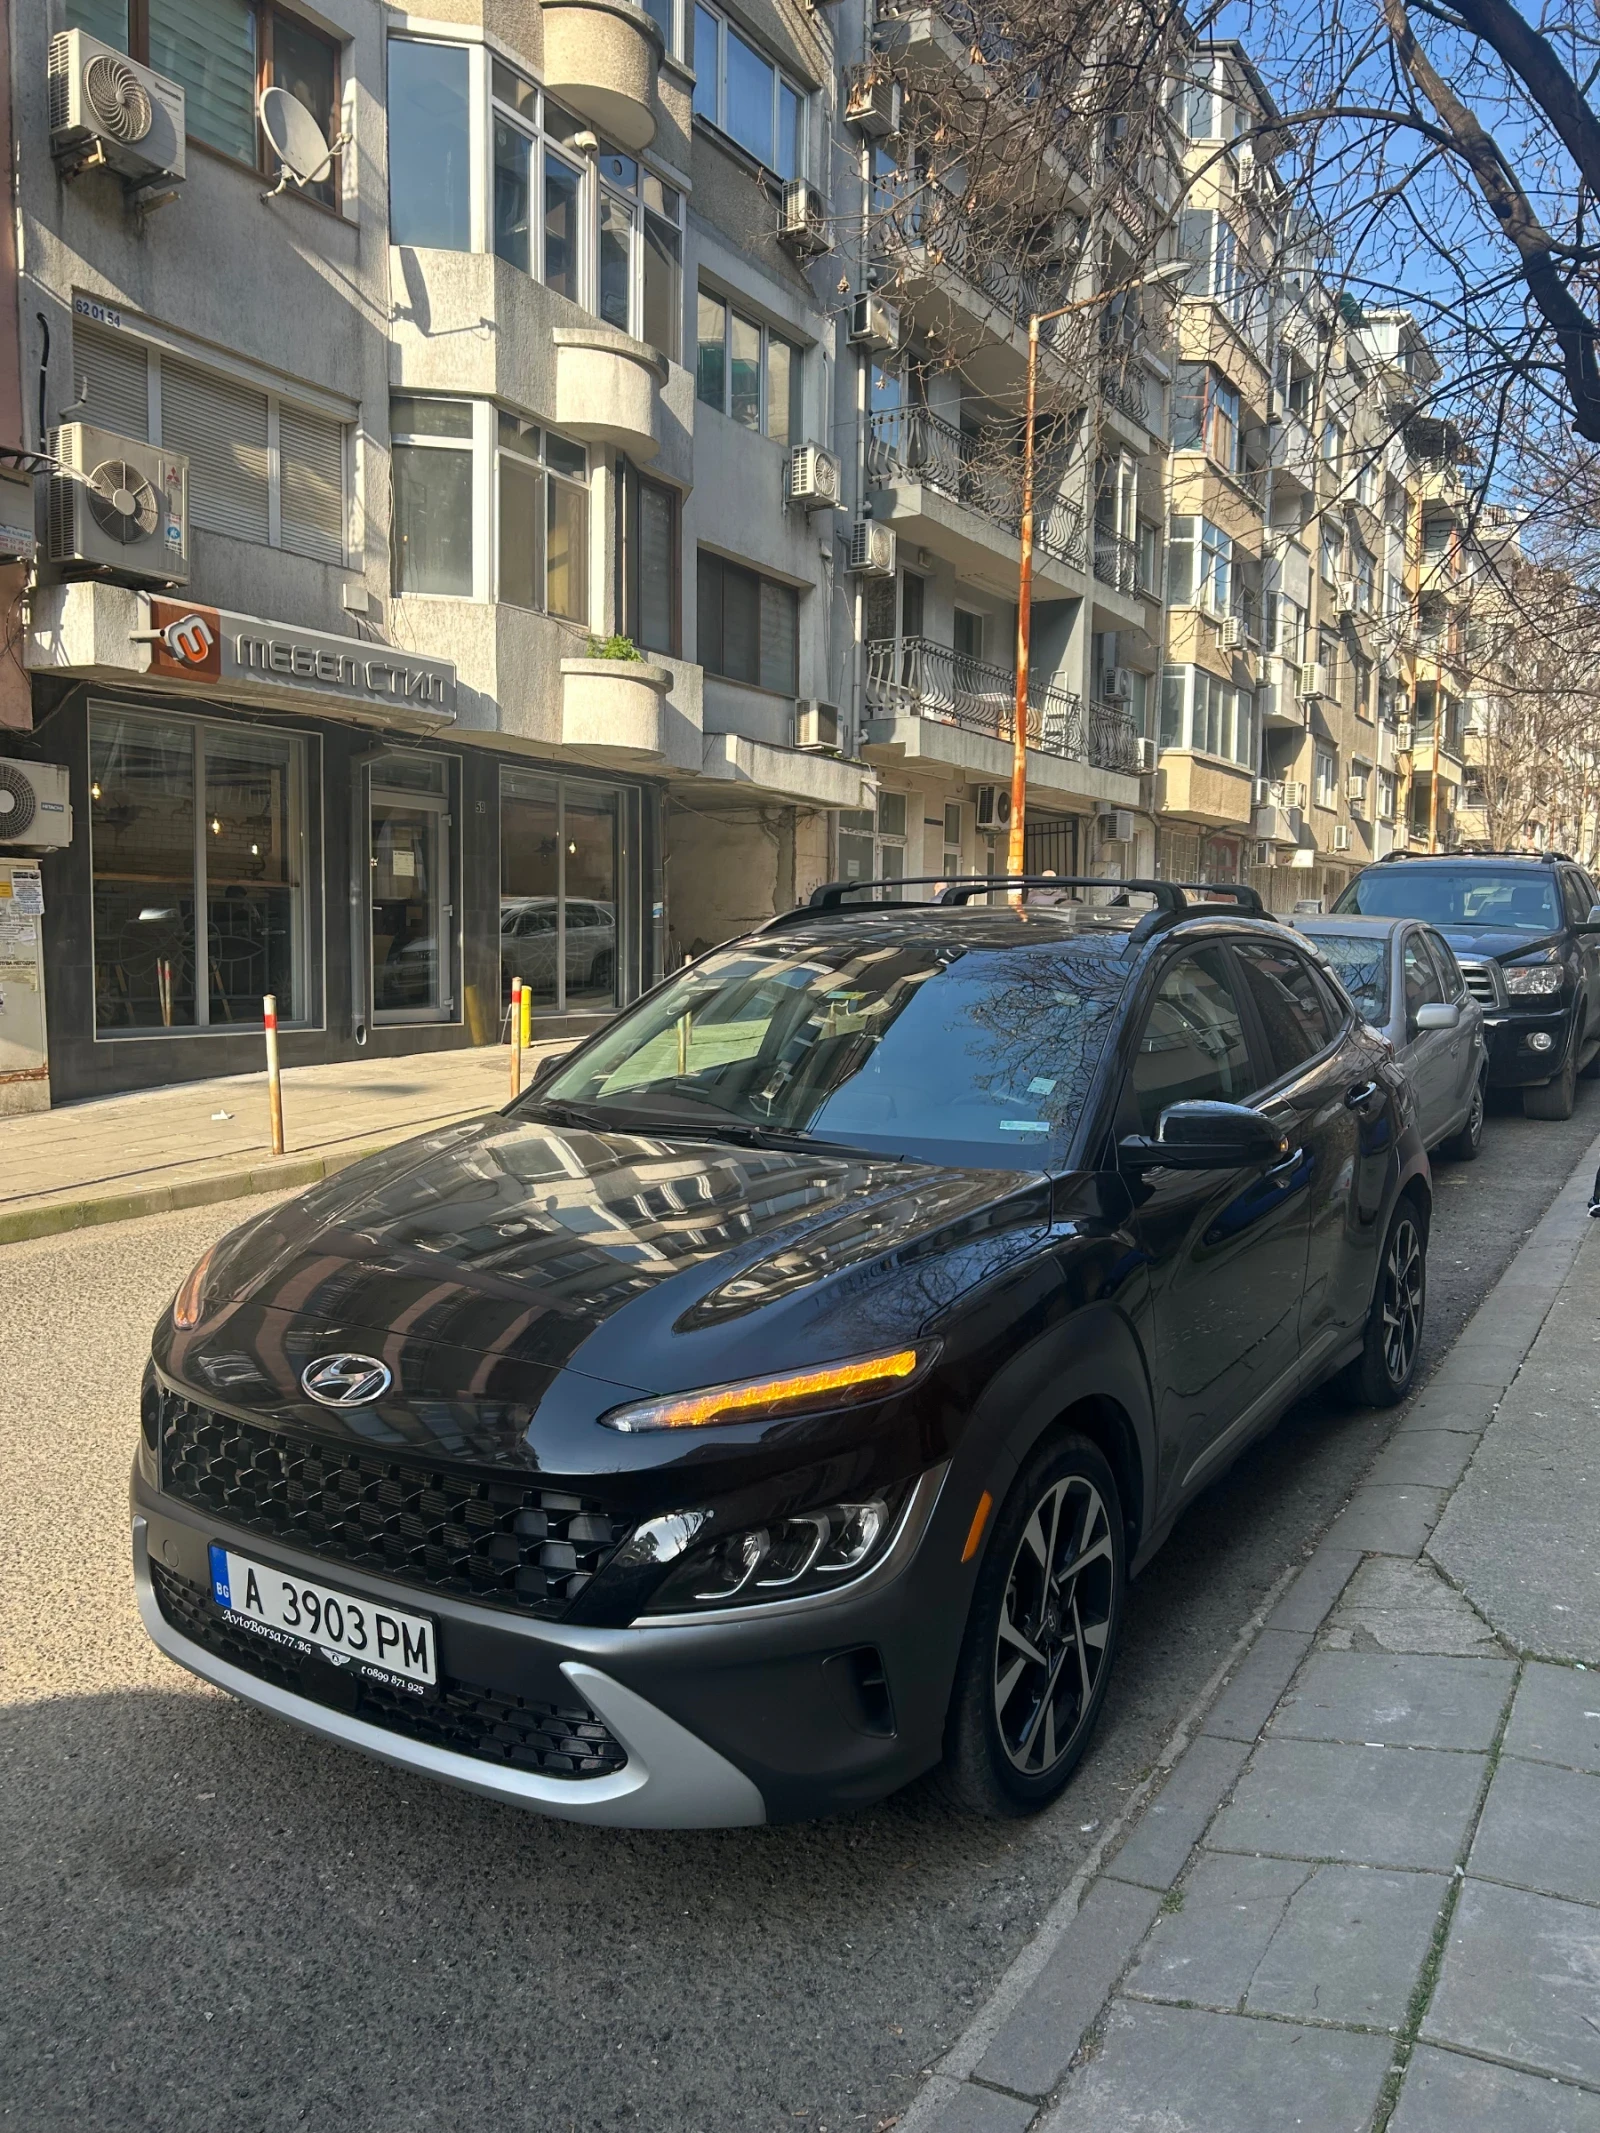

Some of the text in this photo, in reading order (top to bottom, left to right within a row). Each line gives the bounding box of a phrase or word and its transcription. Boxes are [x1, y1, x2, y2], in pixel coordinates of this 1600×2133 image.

[76, 300, 120, 328] 62 01 54
[235, 633, 444, 703] МЕБЕЛ СТИЛ
[42, 803, 63, 812] HITACHI
[475, 800, 486, 813] 59
[216, 1582, 230, 1598] BG
[245, 1567, 429, 1675] A 3903 PM
[366, 1667, 425, 1696] 0899 871 925
